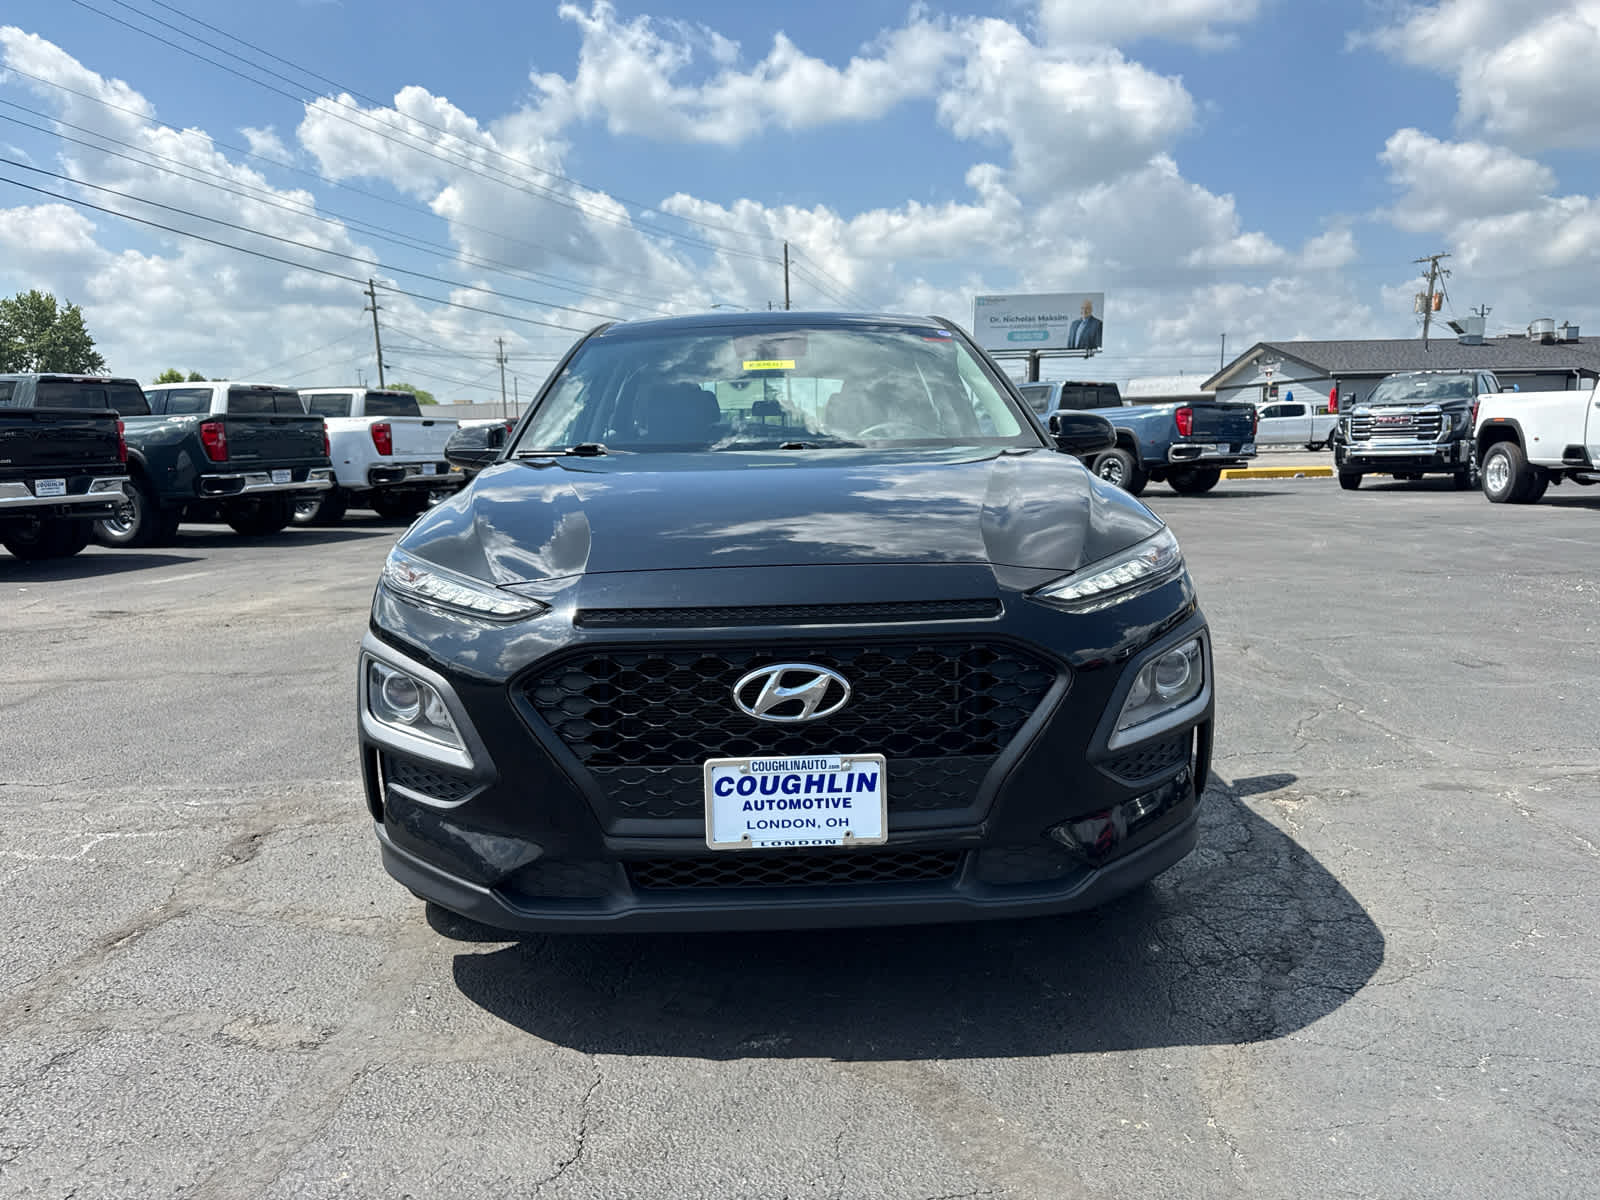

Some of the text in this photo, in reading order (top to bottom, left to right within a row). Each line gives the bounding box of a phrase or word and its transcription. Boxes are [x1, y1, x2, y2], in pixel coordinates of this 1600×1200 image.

[1003, 315, 1036, 323] Nicholas
[714, 773, 878, 797] COUGHLIN
[742, 797, 852, 811] AUTOMOTIVE
[746, 818, 849, 830] LONDON, OH
[761, 839, 837, 847] LONDON
